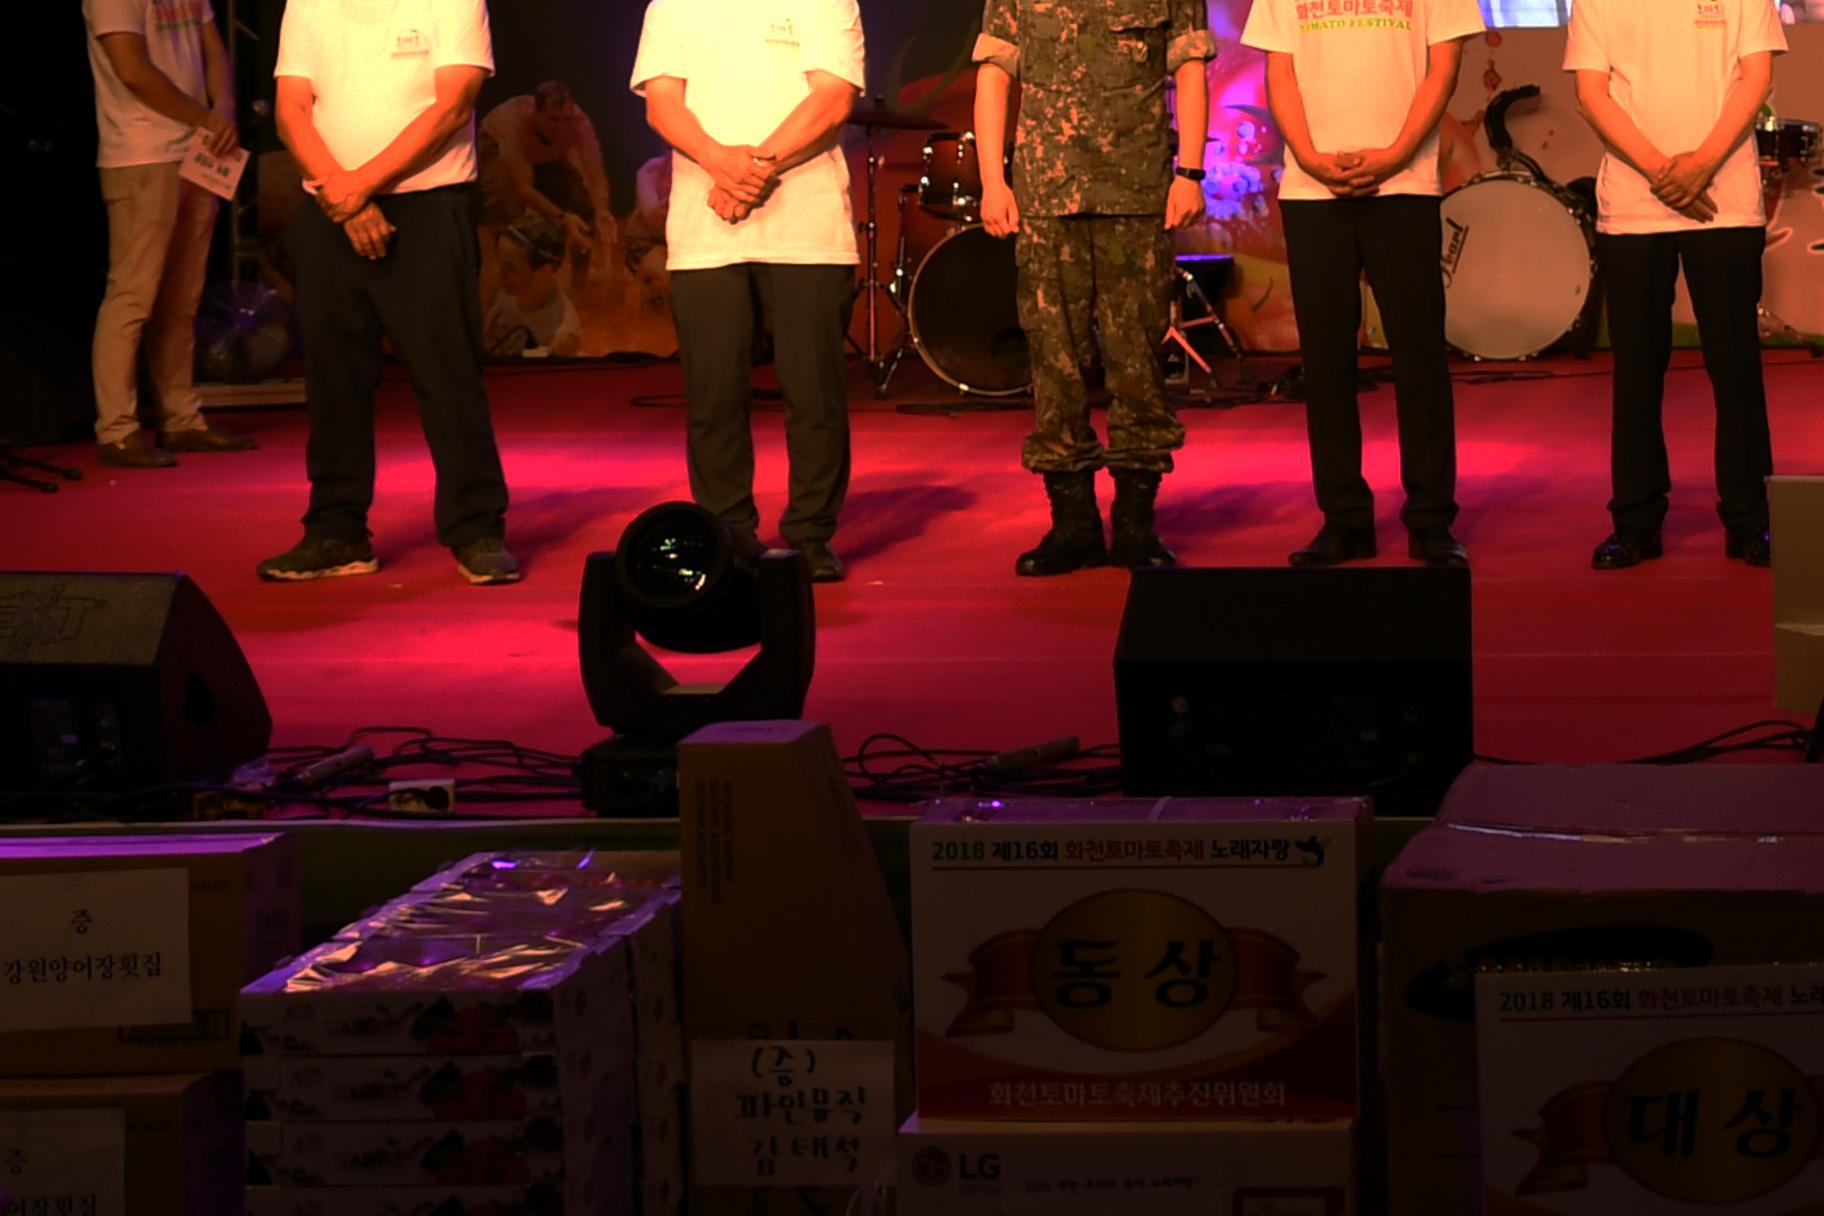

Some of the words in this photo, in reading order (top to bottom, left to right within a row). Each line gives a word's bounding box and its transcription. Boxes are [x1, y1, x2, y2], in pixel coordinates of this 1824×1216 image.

[1350, 17, 1412, 31] FESTIVAL
[932, 841, 985, 862] 2018
[992, 841, 1057, 862] 제16회
[1065, 839, 1203, 861] 화천토마토축제
[1211, 837, 1289, 861] 노래자랑
[71, 910, 92, 935] 증
[3, 951, 161, 985] 강원양어장횟집
[1500, 990, 1554, 1011] 2018
[1561, 988, 1631, 1011] 제16회
[1637, 986, 1783, 1010] 화천토마토축제
[990, 1080, 1286, 1108] 화천토마토축제추진위원회
[960, 1154, 1000, 1179] LG
